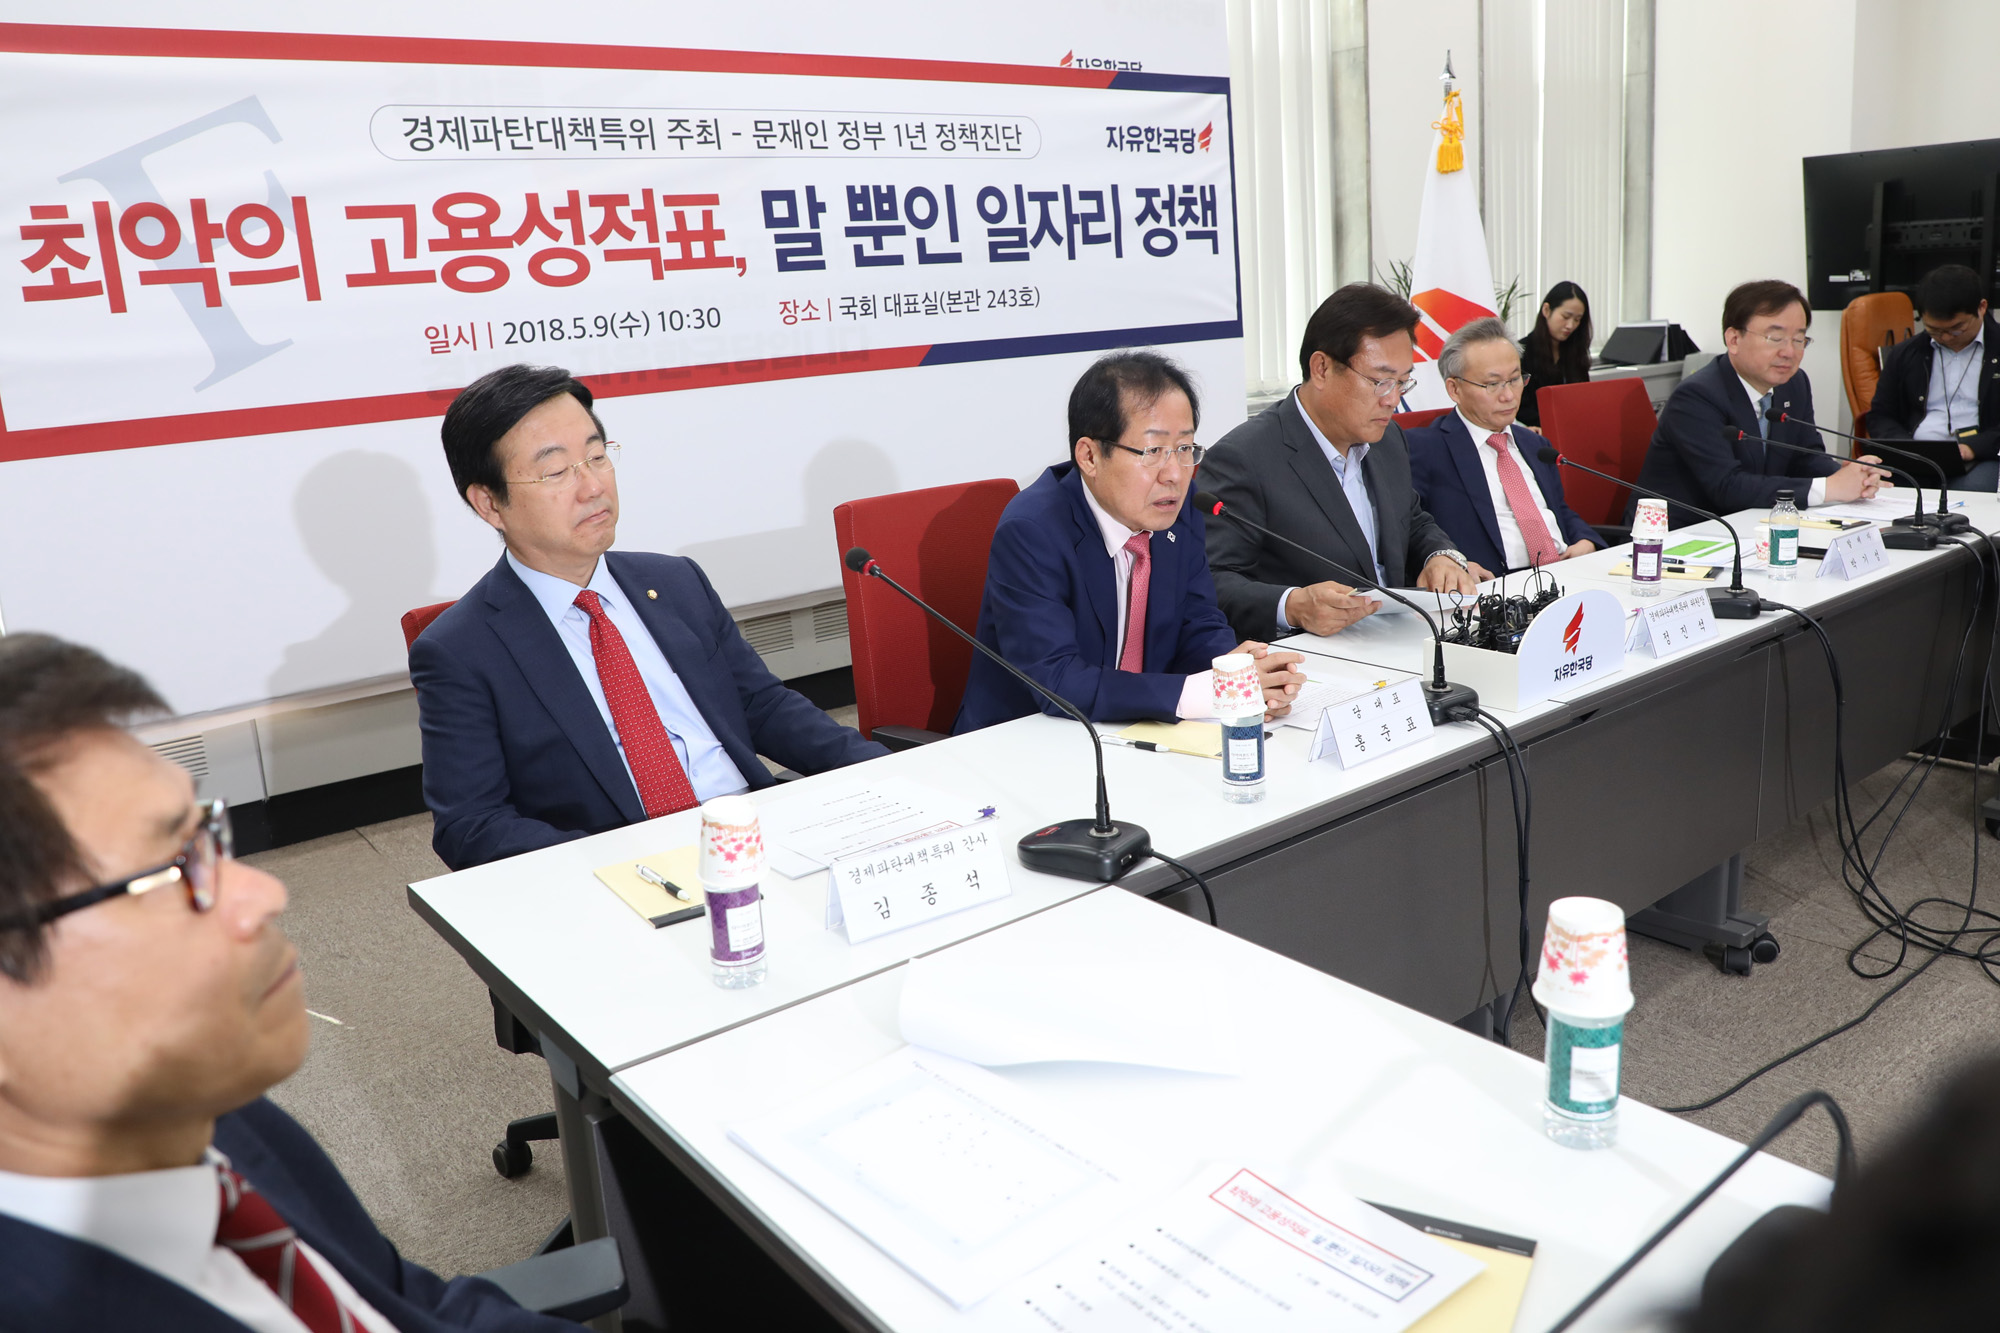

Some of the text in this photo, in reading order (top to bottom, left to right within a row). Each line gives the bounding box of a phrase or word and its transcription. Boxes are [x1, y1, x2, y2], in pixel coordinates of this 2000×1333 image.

[403, 116, 655, 152] 경제파탄대책특위
[668, 119, 721, 151] 주최
[753, 119, 828, 150] 문재인
[838, 121, 886, 151] 정부
[893, 121, 927, 151] 1년
[936, 123, 1022, 152] 정책진단
[1106, 126, 1196, 154] 자유한국당
[20, 184, 1219, 314] 최악의 고용성적표, 말 뿐인 일자리 정책
[779, 299, 821, 325] 장소
[839, 294, 878, 321] 국회
[884, 288, 981, 318] 대표실(본관
[987, 286, 1041, 309] 243호)
[425, 323, 477, 354] 일시
[503, 310, 650, 345] 2018.5.9(수)
[658, 308, 721, 333] 10:30
[1554, 654, 1593, 682] 자유한국당
[849, 840, 955, 884] 경제파탄대책특위
[962, 831, 988, 852] 간사
